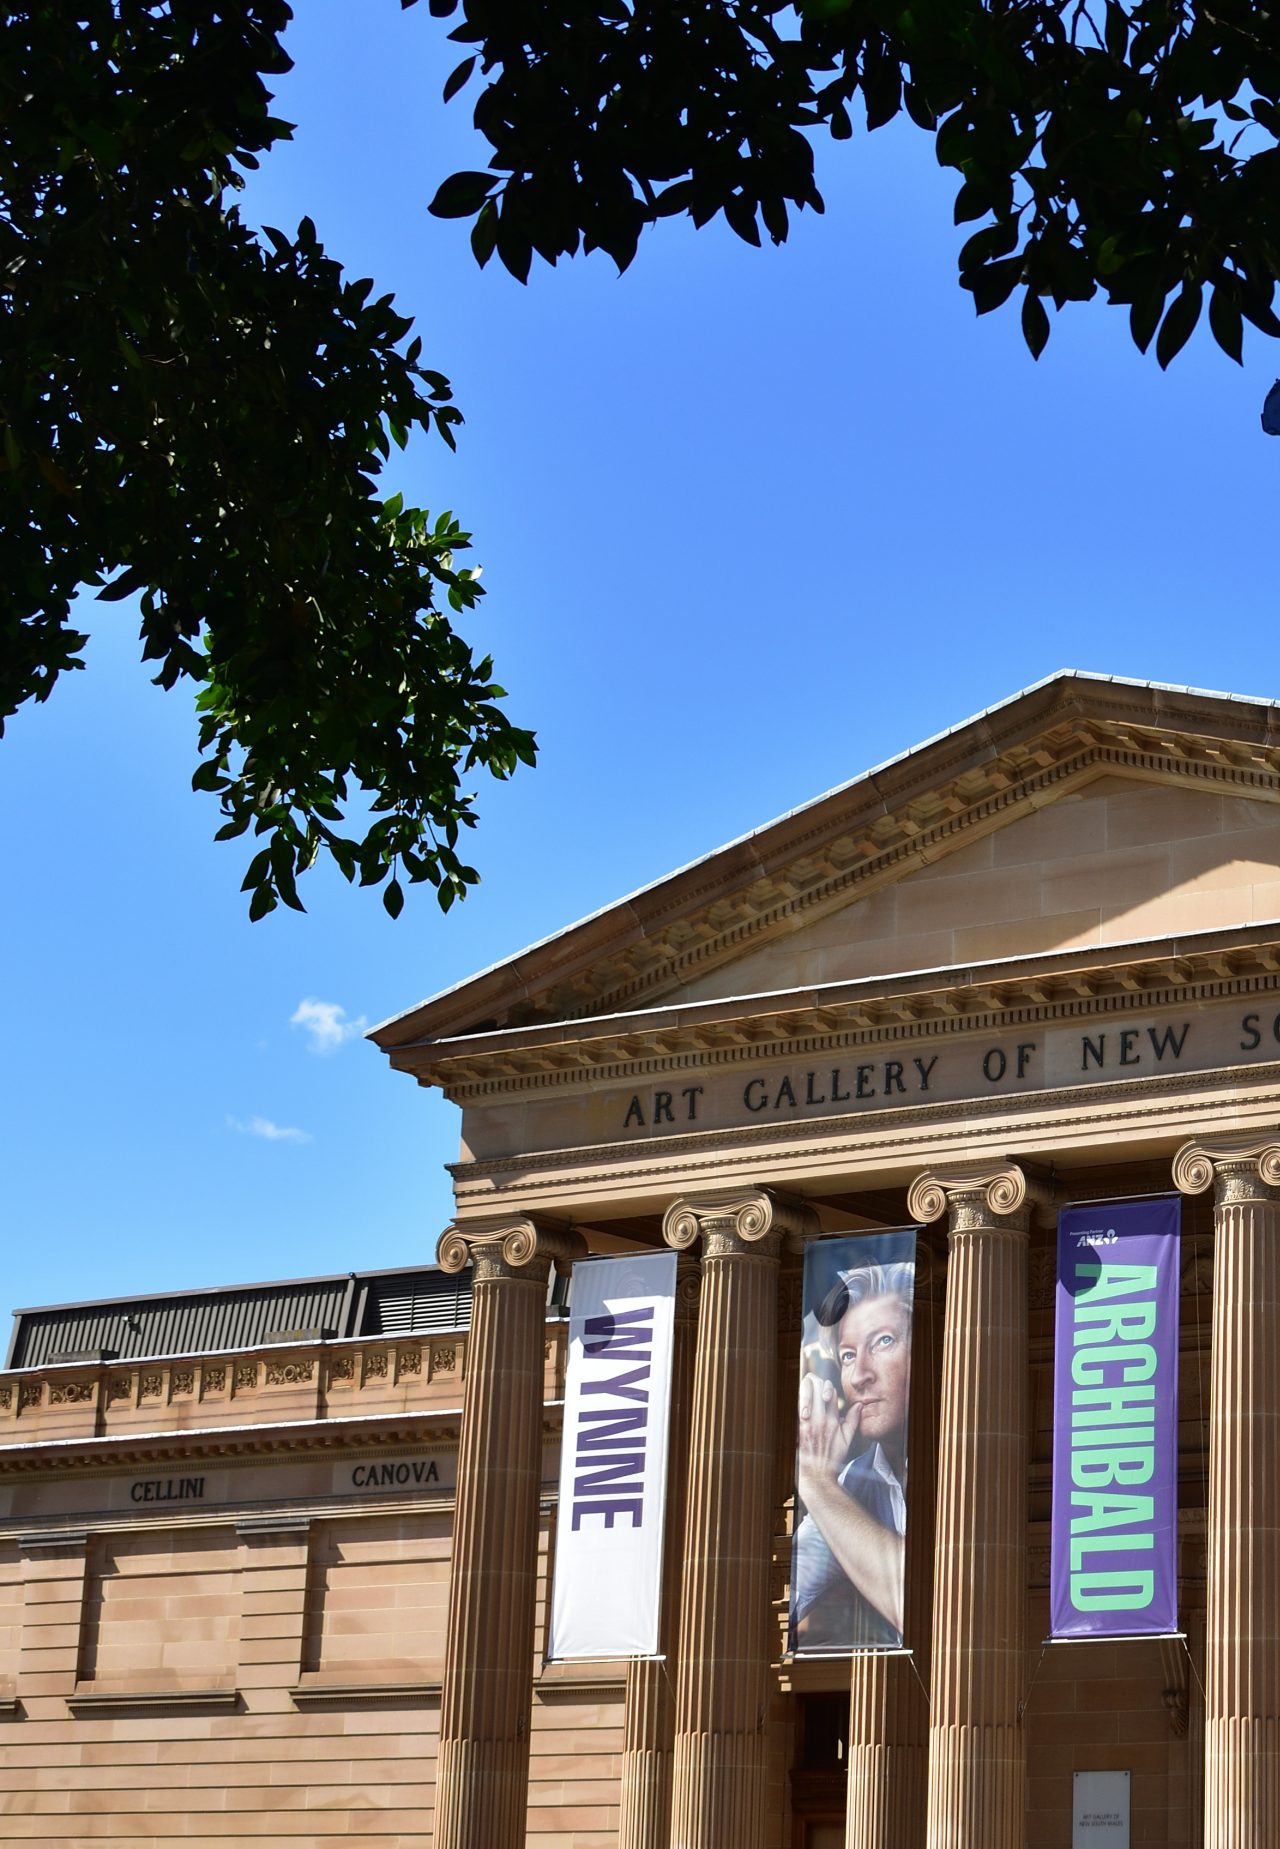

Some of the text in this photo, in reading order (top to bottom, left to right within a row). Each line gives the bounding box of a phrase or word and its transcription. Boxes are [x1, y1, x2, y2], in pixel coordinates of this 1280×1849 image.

[623, 1086, 703, 1128] ART
[743, 1055, 938, 1112] GALLERY
[983, 1043, 1036, 1082] OF
[1082, 1023, 1190, 1071] NEW
[1076, 1234, 1104, 1247] ANZ
[571, 1306, 655, 1532] WYNNE
[1070, 1263, 1158, 1612] ARCHIBALD
[130, 1477, 205, 1502] CELLINI
[352, 1461, 439, 1487] CANOVA
